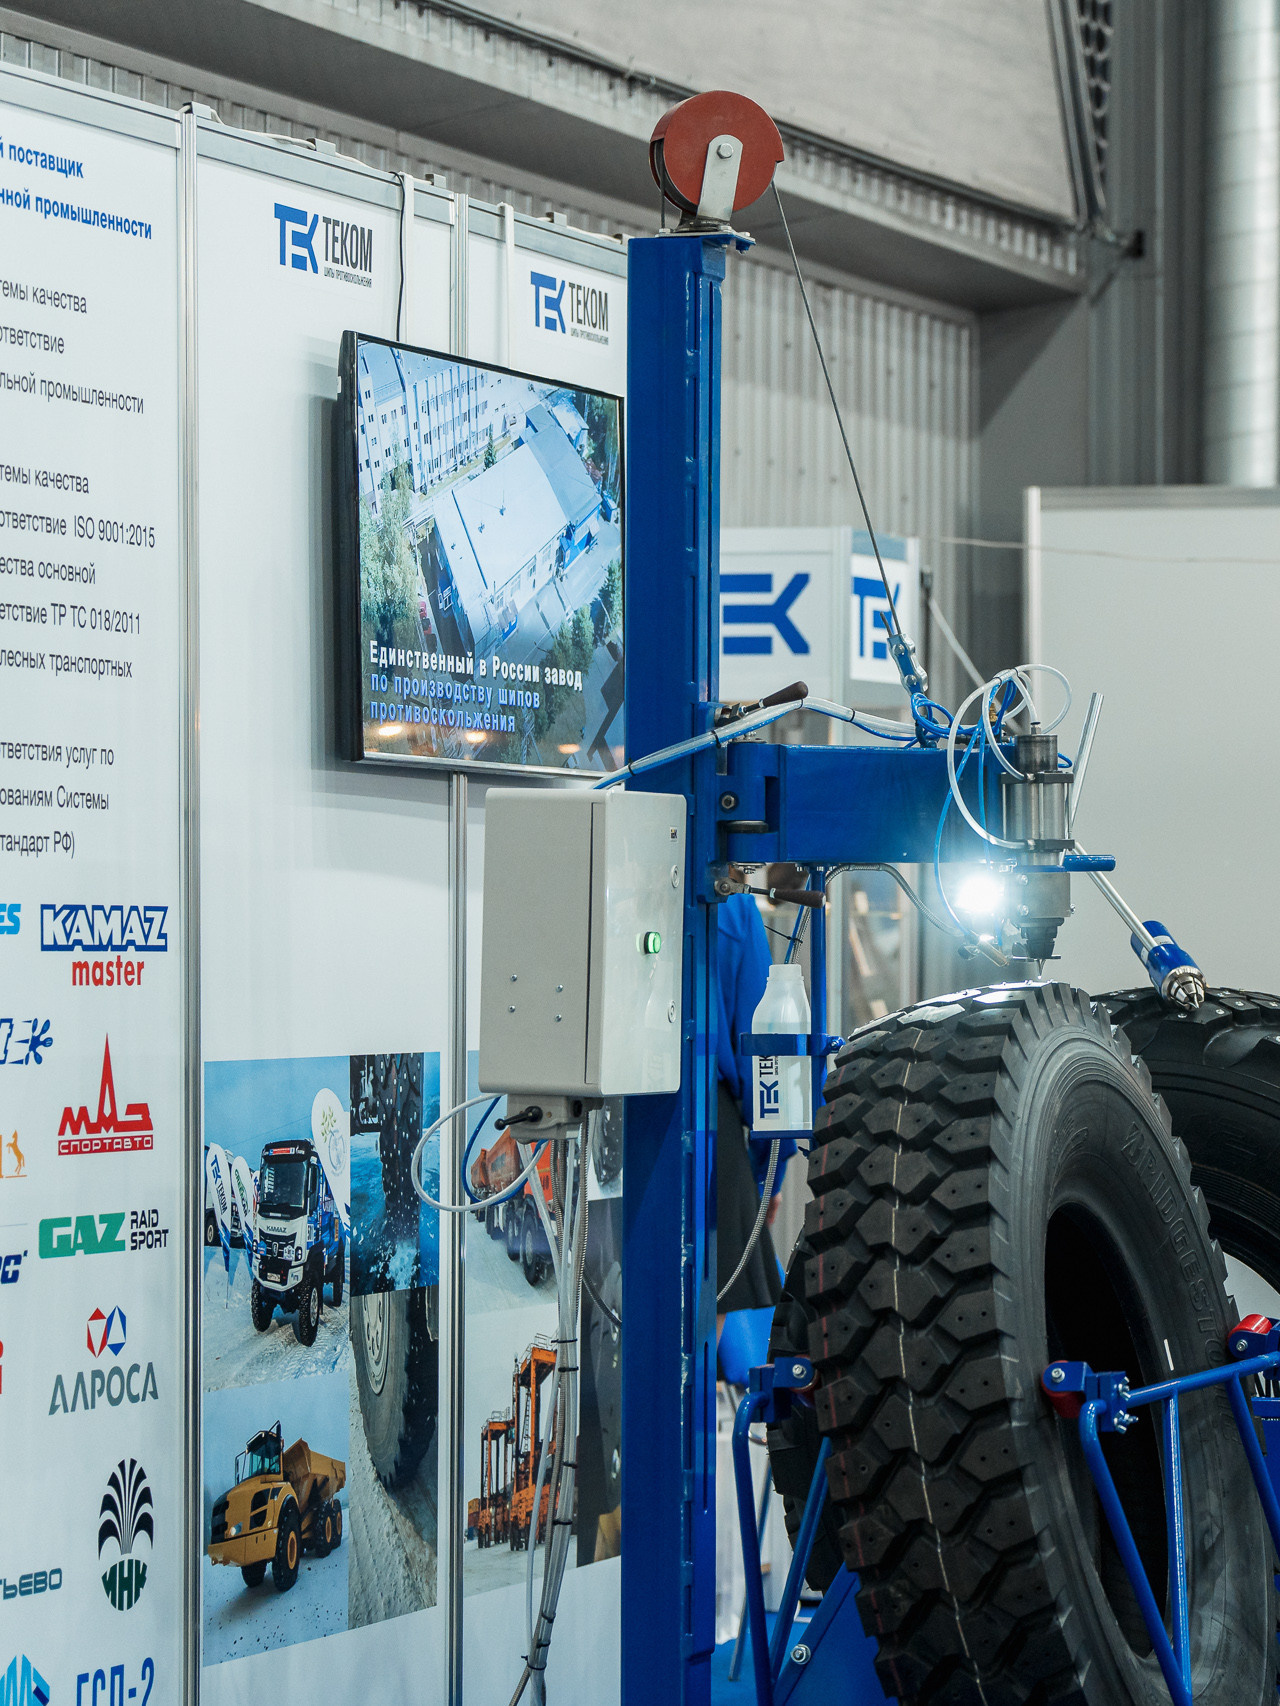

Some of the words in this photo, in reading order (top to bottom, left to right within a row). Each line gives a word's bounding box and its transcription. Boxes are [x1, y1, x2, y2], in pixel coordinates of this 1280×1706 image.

[9, 144, 84, 178] поставщик
[35, 196, 152, 240] промышленности
[322, 215, 373, 273] ТЕКОМ
[0, 280, 28, 301] емы
[32, 286, 87, 314] качества
[568, 282, 609, 332] ТЕКОМ
[40, 379, 144, 414] промышленности
[34, 470, 90, 494] качества
[74, 515, 95, 540] ISO
[98, 519, 156, 548] 9001:2015
[37, 561, 97, 585] основной
[50, 602, 67, 627] ТР
[70, 604, 87, 629] ТС
[90, 607, 141, 635] 018/2011
[49, 653, 133, 680] транспортных
[369, 640, 475, 675] Единственный
[479, 659, 488, 676] в
[492, 655, 541, 683] России
[544, 667, 584, 691] завод
[371, 673, 388, 692] по
[394, 676, 493, 708] производству
[498, 690, 541, 709] шипов
[370, 701, 516, 733] противоскольжения
[65, 745, 98, 770] услуг
[100, 748, 115, 766] по
[56, 785, 109, 810] Системы
[53, 830, 75, 859] РФ)
[40, 903, 169, 952] KAMAZ
[71, 955, 145, 987] master
[59, 1136, 153, 1154] СПОРТАВТО
[39, 1211, 126, 1259] GAZ
[130, 1208, 159, 1229] RAID
[130, 1228, 169, 1251] SPORT
[266, 1225, 287, 1233] KAMAZ
[48, 1361, 159, 1416] АЛРОСА
